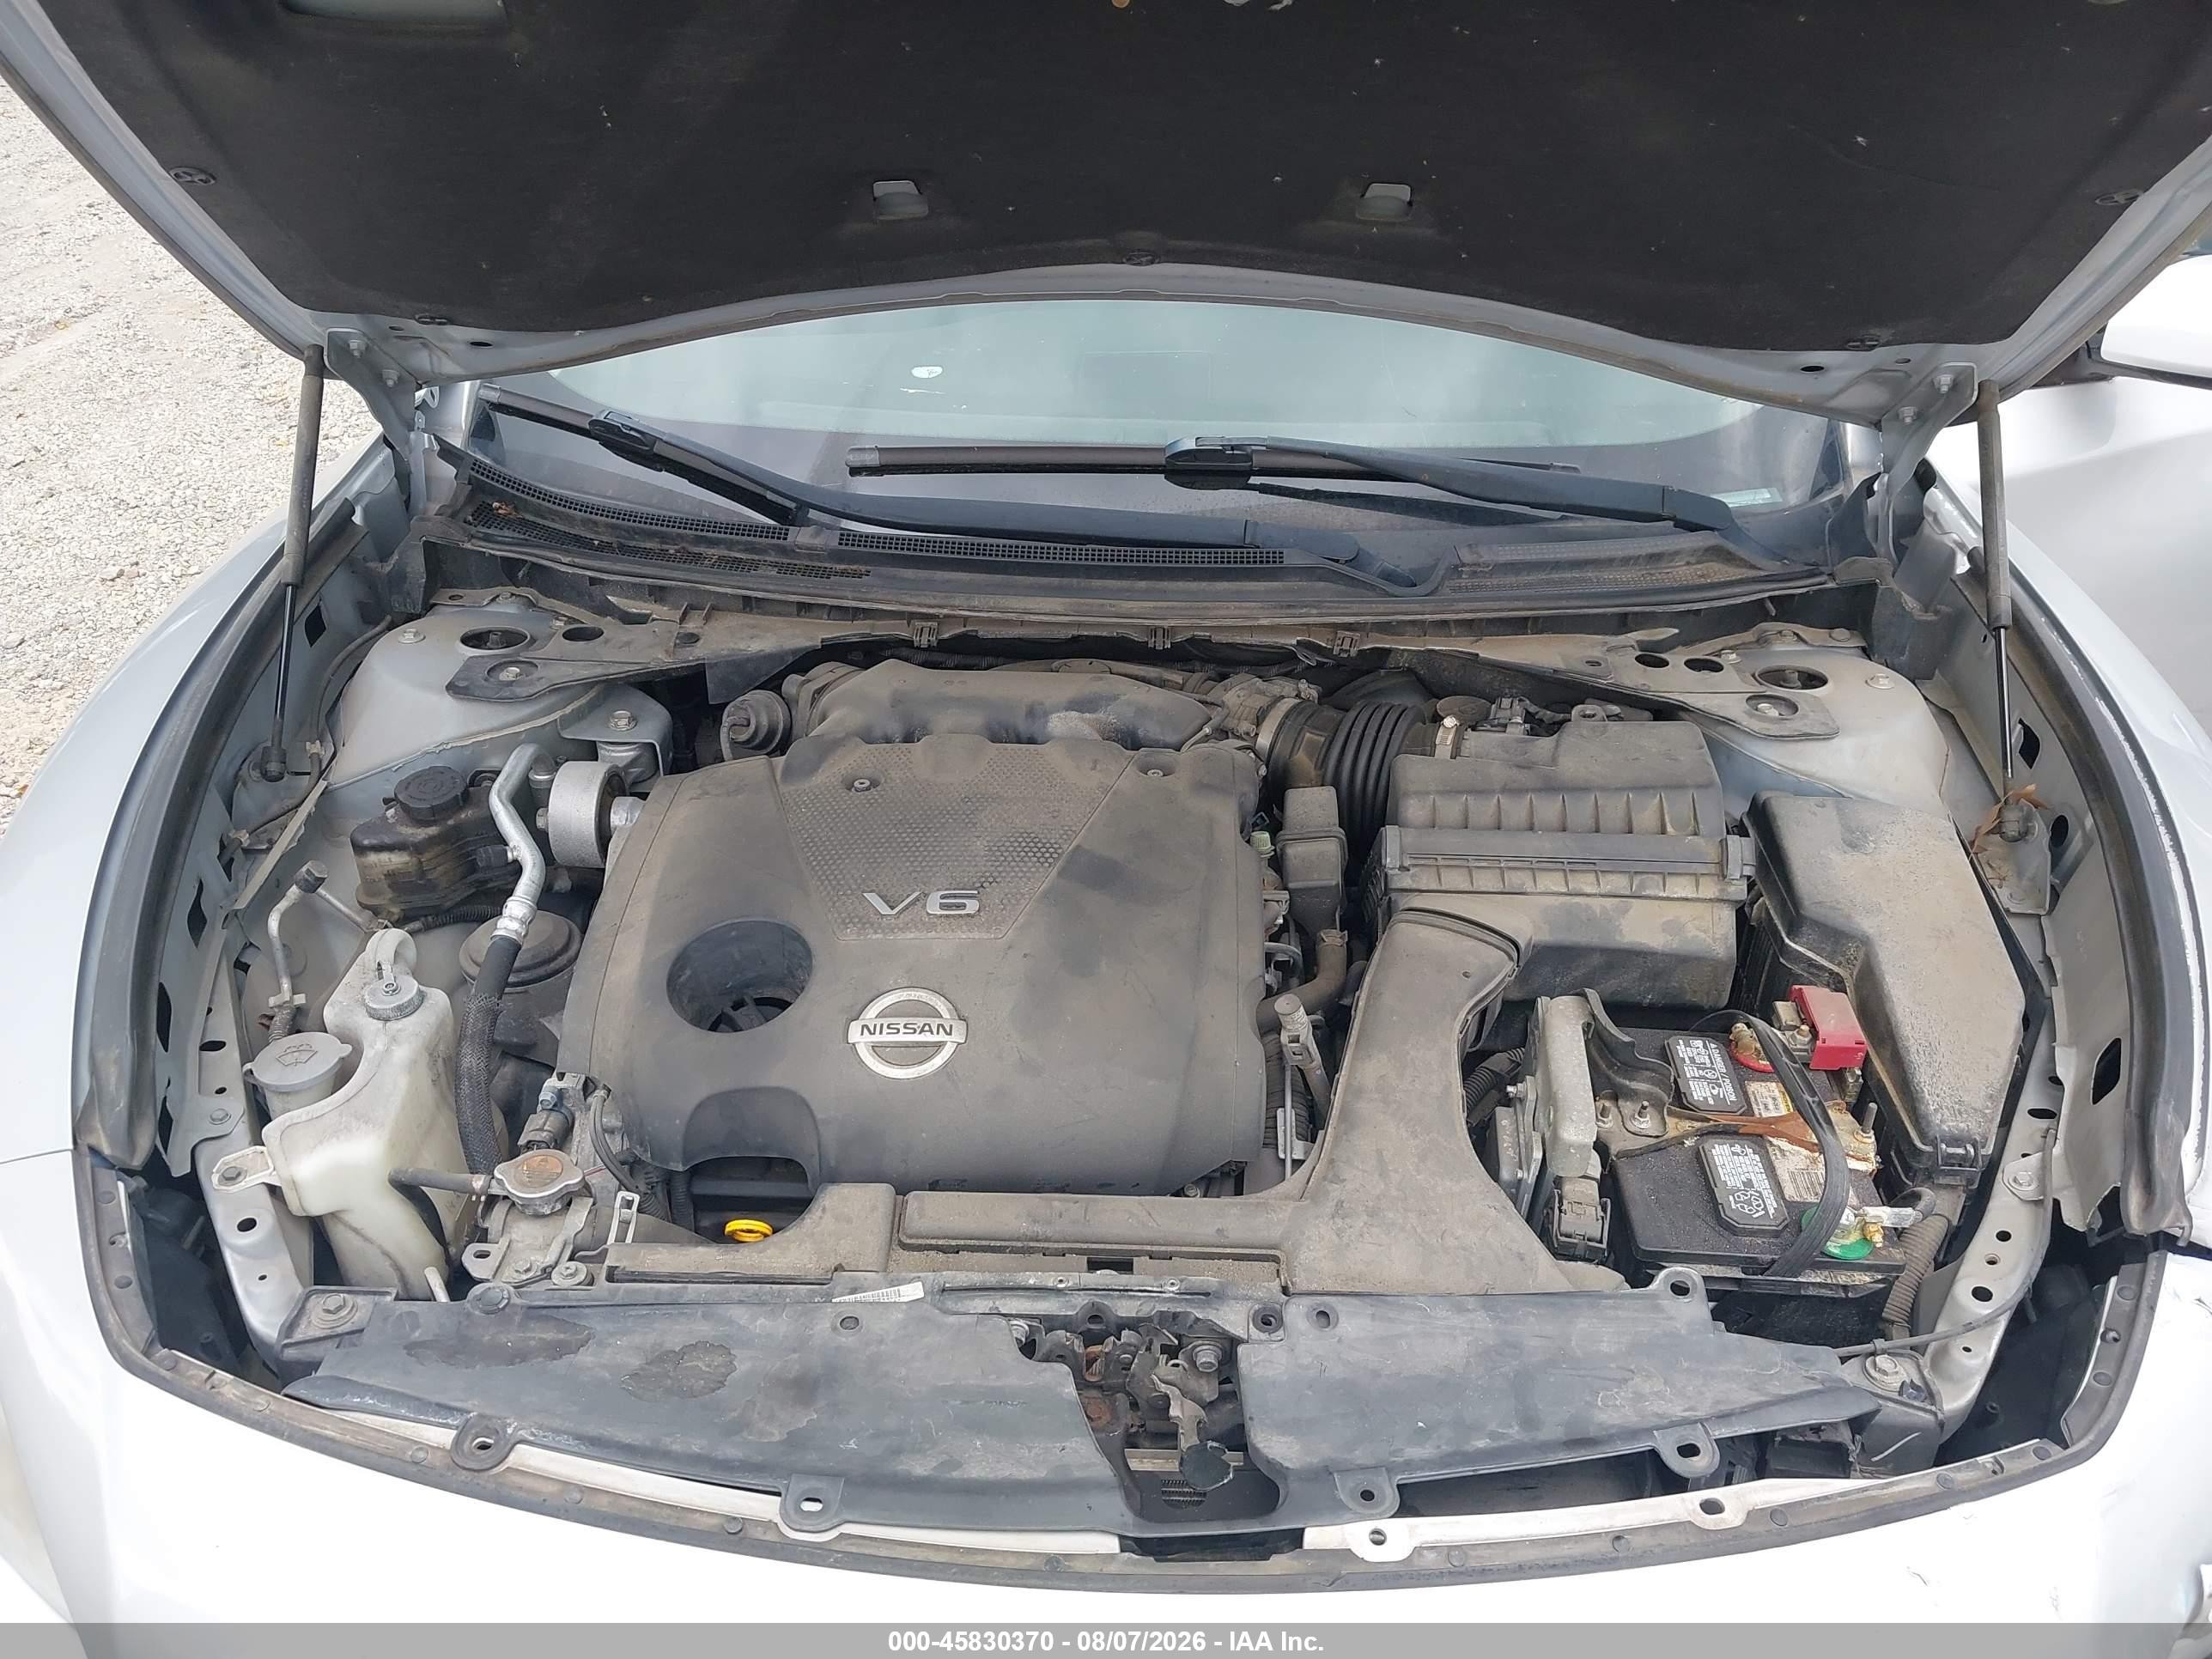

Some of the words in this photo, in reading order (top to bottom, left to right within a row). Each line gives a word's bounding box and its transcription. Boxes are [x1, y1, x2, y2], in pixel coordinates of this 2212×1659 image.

[861, 890, 980, 915] V6
[860, 1022, 953, 1037] NISSAN
[1712, 1048, 1727, 1073] DANGER
[1723, 1078, 1737, 1101] POISON
